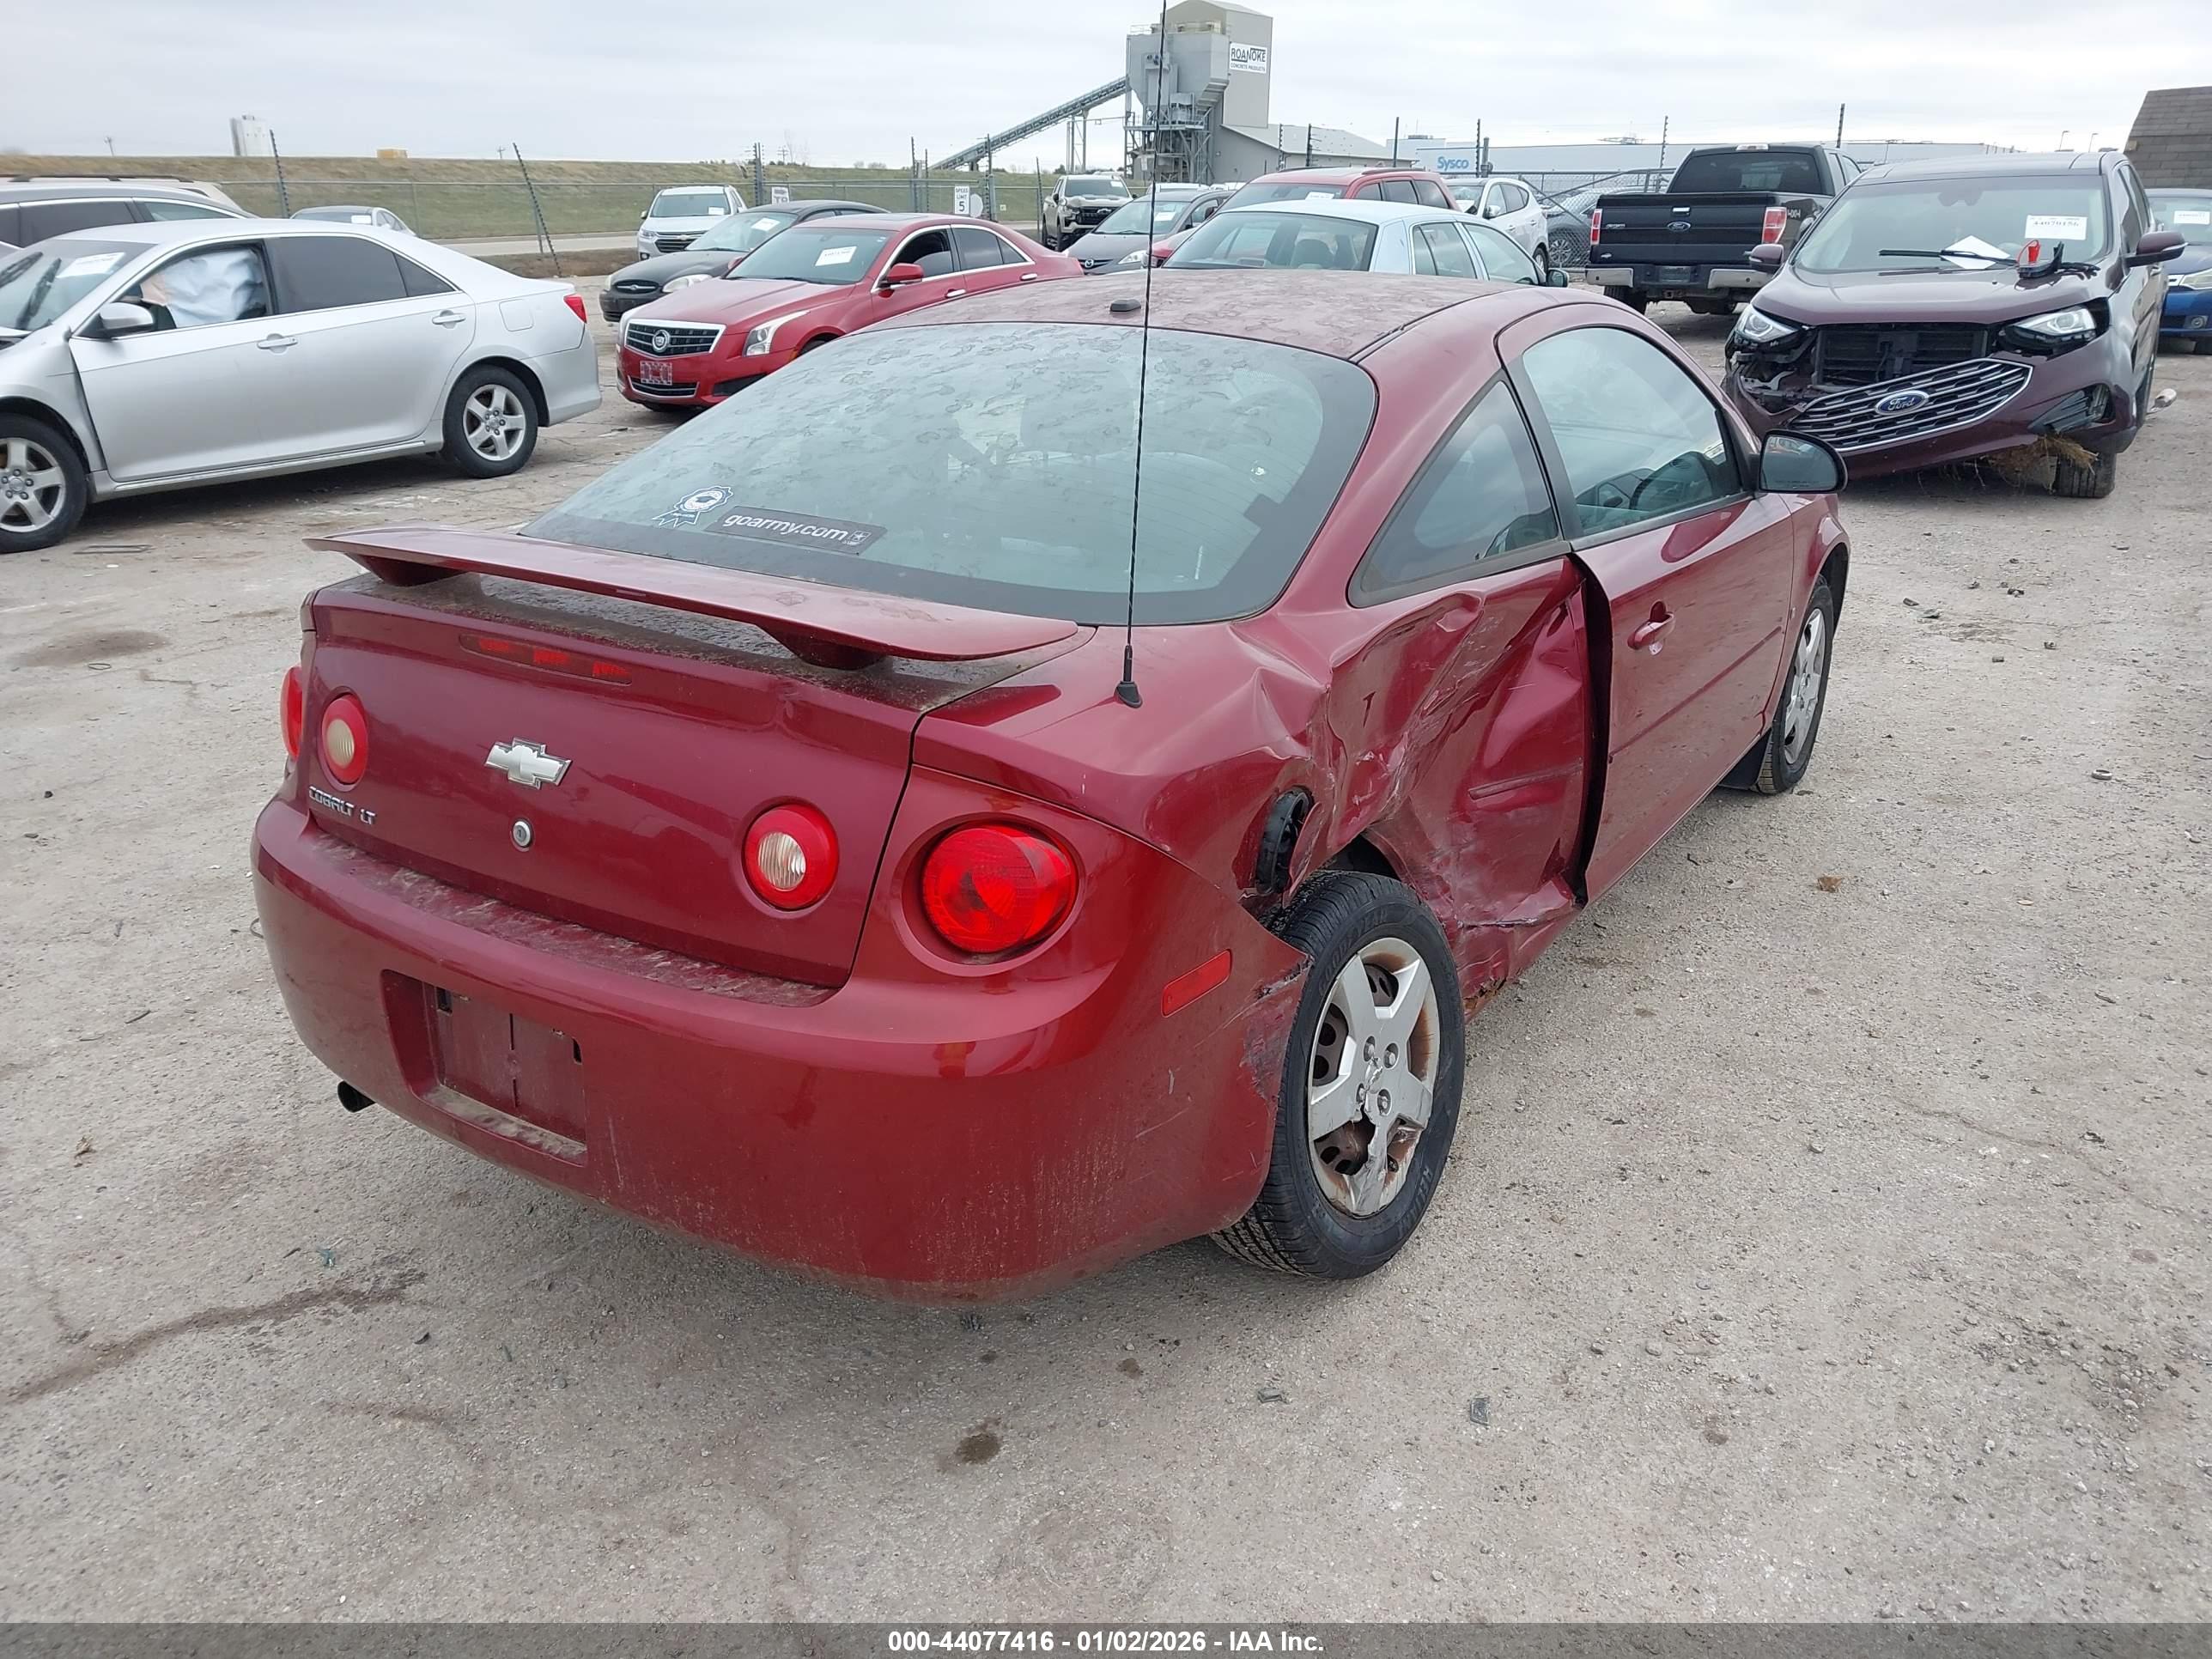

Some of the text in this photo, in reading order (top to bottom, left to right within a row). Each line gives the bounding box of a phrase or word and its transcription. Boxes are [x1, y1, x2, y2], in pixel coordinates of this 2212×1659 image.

[1231, 47, 1266, 62] ROANOKE
[1437, 156, 1469, 171] Sysco
[958, 201, 965, 212] 5
[1887, 397, 1916, 411] Ford
[722, 513, 848, 541] goarmy.com
[308, 786, 376, 825] COBALT LT
